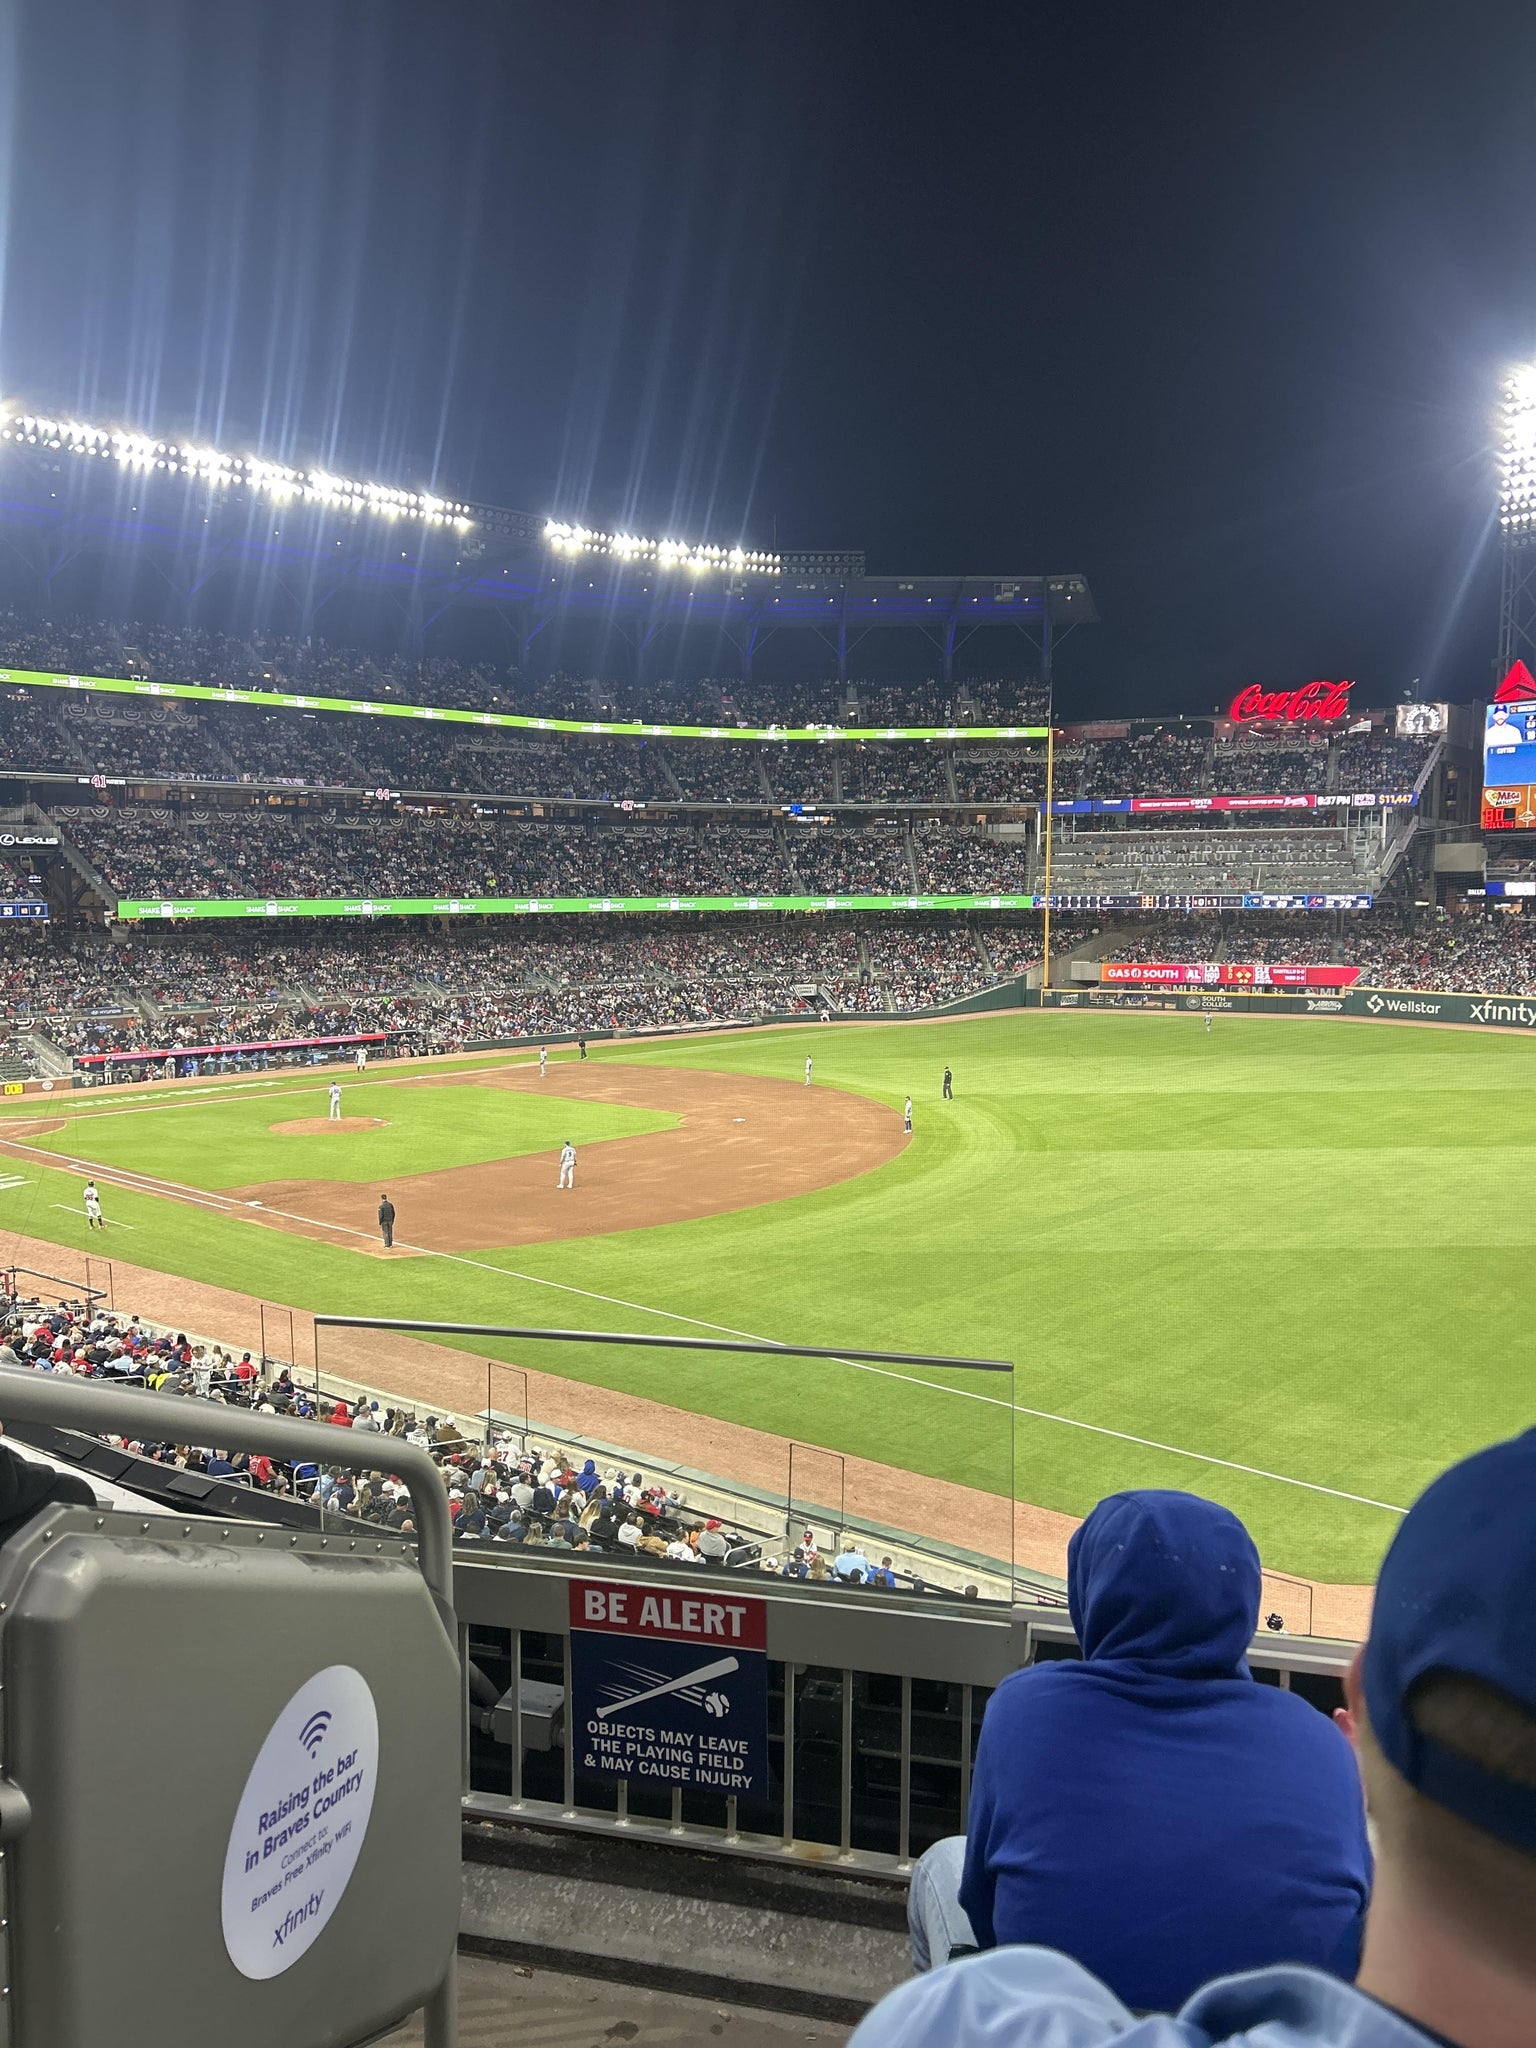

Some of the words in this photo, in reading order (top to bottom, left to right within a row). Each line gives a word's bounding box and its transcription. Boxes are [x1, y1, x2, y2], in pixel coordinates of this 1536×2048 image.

[1230, 681, 1355, 722] Coca-Cola
[1379, 794, 1413, 805] $11,447
[15, 836, 59, 845] LEXUS
[1123, 846, 1170, 862] HANK
[1176, 845, 1239, 862] AARON
[1249, 843, 1334, 861] TERRACE
[1108, 969, 1130, 978] GAS
[1143, 969, 1179, 979] SOUTH
[1186, 969, 1202, 979] AL
[1386, 1000, 1442, 1014] Wellstar
[1469, 1000, 1536, 1026] xfinity
[585, 1590, 628, 1624] BE
[639, 1596, 747, 1638] ALERT
[587, 1720, 655, 1741] OBJECTS
[660, 1730, 694, 1747] MAY
[699, 1735, 749, 1755] LEAVE
[591, 1737, 621, 1754] THE
[626, 1742, 693, 1764] PLAYING
[699, 1752, 744, 1770] FIELD
[584, 1753, 597, 1767] &
[601, 1756, 633, 1772] MAY
[638, 1761, 690, 1780] CAUSE
[696, 1769, 753, 1789] INJURY
[257, 1784, 310, 1836] Raising
[312, 1765, 335, 1795] the
[336, 1749, 358, 1777] bar
[244, 1851, 260, 1873] in
[262, 1813, 311, 1860] Braves
[312, 1769, 364, 1821] Country
[280, 1831, 317, 1869] Connect
[317, 1826, 329, 1844] to:
[250, 1881, 283, 1913] Braves
[283, 1863, 304, 1889] Free
[305, 1840, 333, 1868] Xfinity
[334, 1820, 352, 1846] WiFi
[272, 1889, 325, 1949] xfinity
